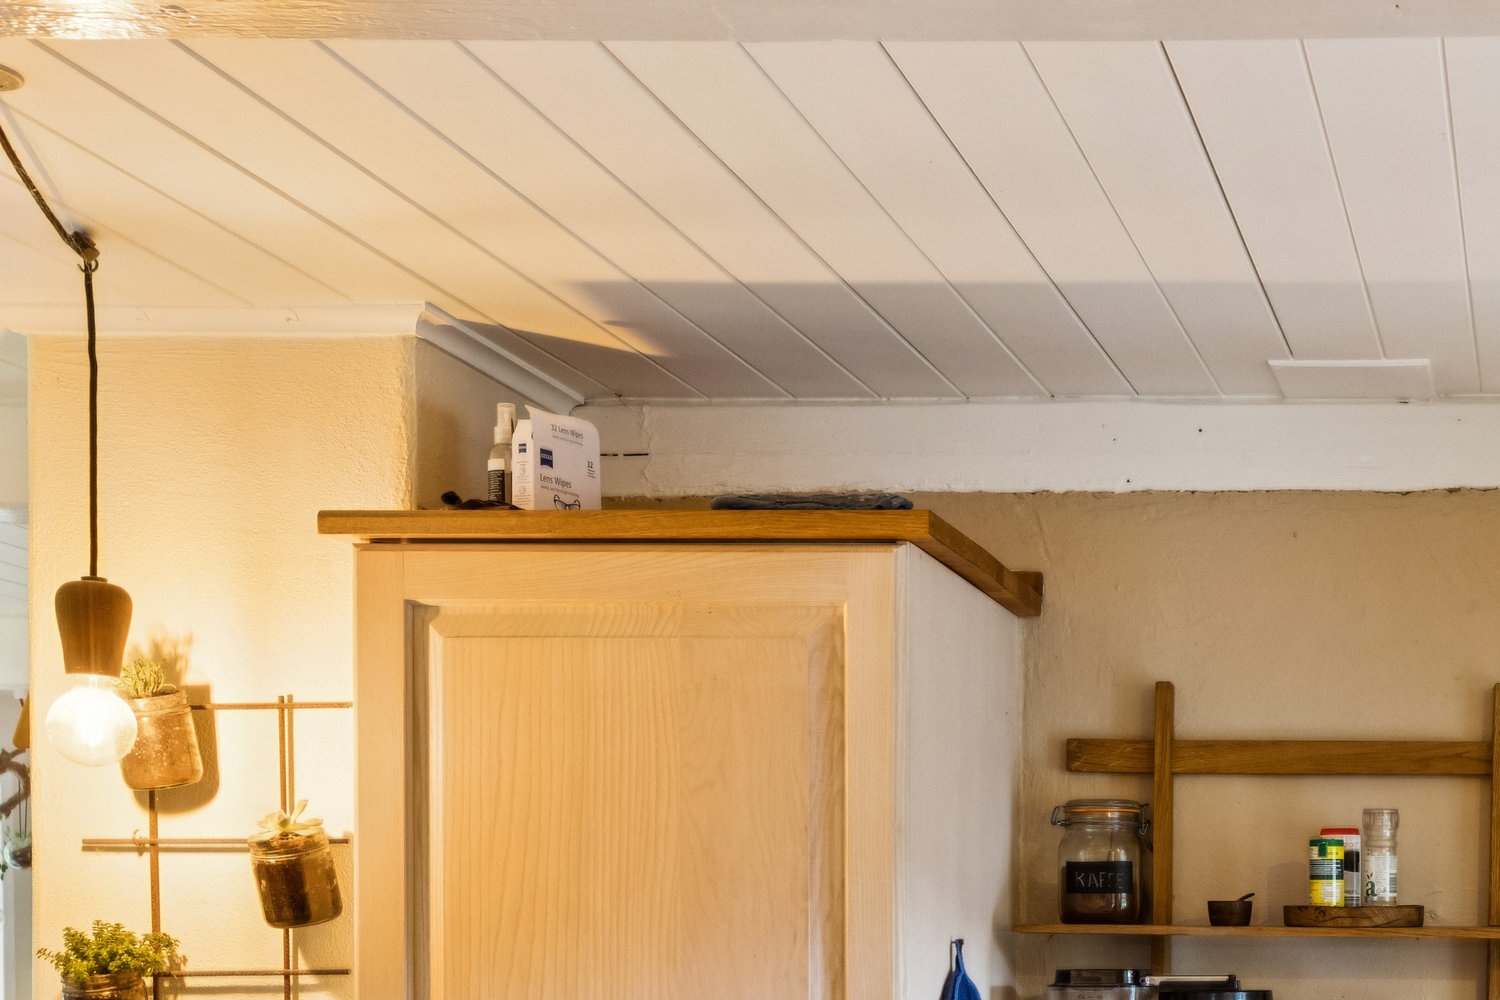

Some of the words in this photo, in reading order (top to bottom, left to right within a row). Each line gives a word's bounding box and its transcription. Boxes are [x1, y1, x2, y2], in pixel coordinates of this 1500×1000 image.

[558, 426, 569, 435] Lens
[570, 428, 584, 439] Wipes
[540, 474, 553, 485] Lens
[554, 477, 572, 489] Wipes
[1076, 872, 1124, 888] KAFFE
